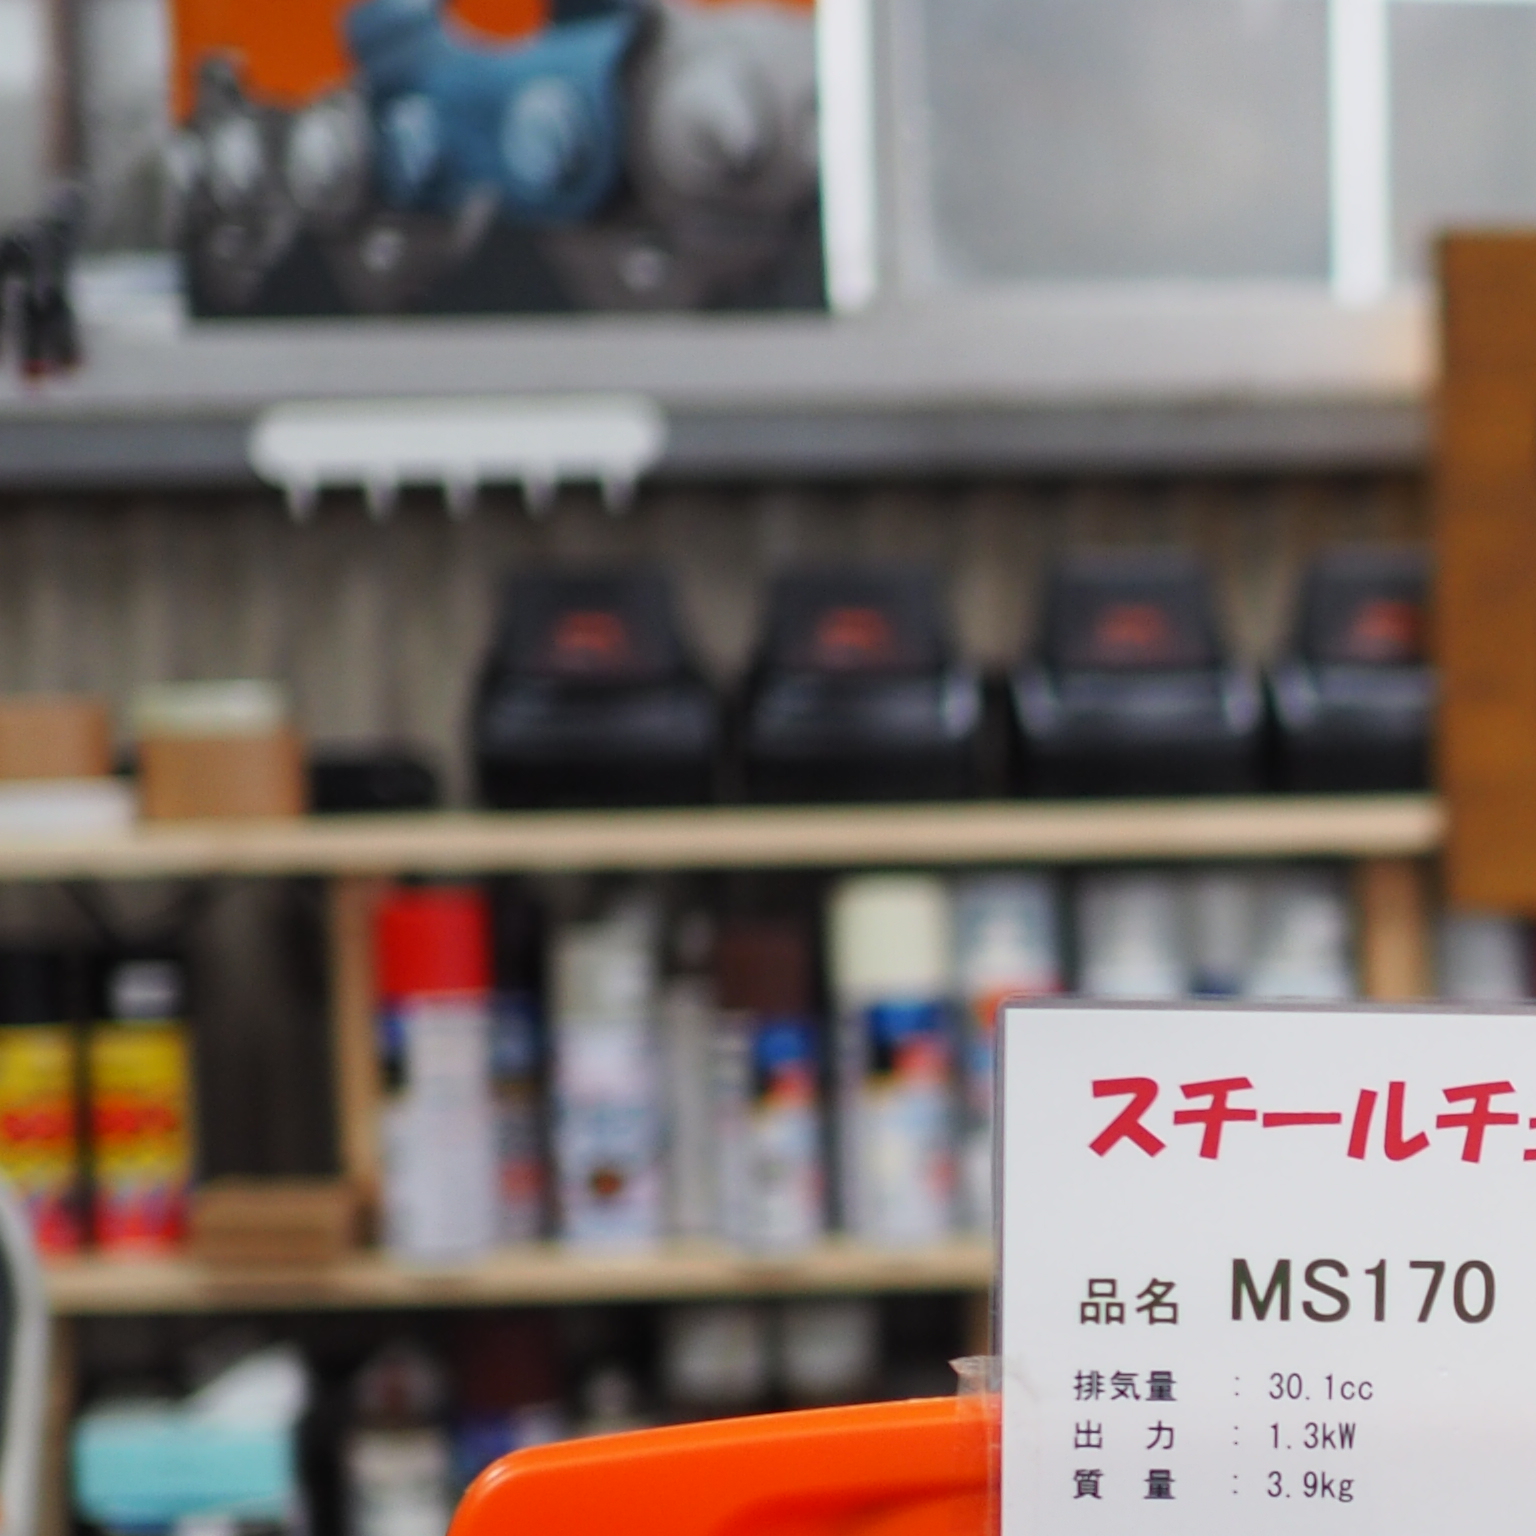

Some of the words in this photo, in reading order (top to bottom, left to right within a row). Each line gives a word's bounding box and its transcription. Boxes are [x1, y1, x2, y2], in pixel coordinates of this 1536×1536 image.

[1080, 1277, 1178, 1325] 品名
[1231, 1258, 1495, 1324] MS170
[1073, 1370, 1176, 1402] 排気量
[1269, 1372, 1373, 1401] 30.1cc
[1270, 1422, 1356, 1449] 1.3kW
[1267, 1470, 1354, 1503] 3.9kg
